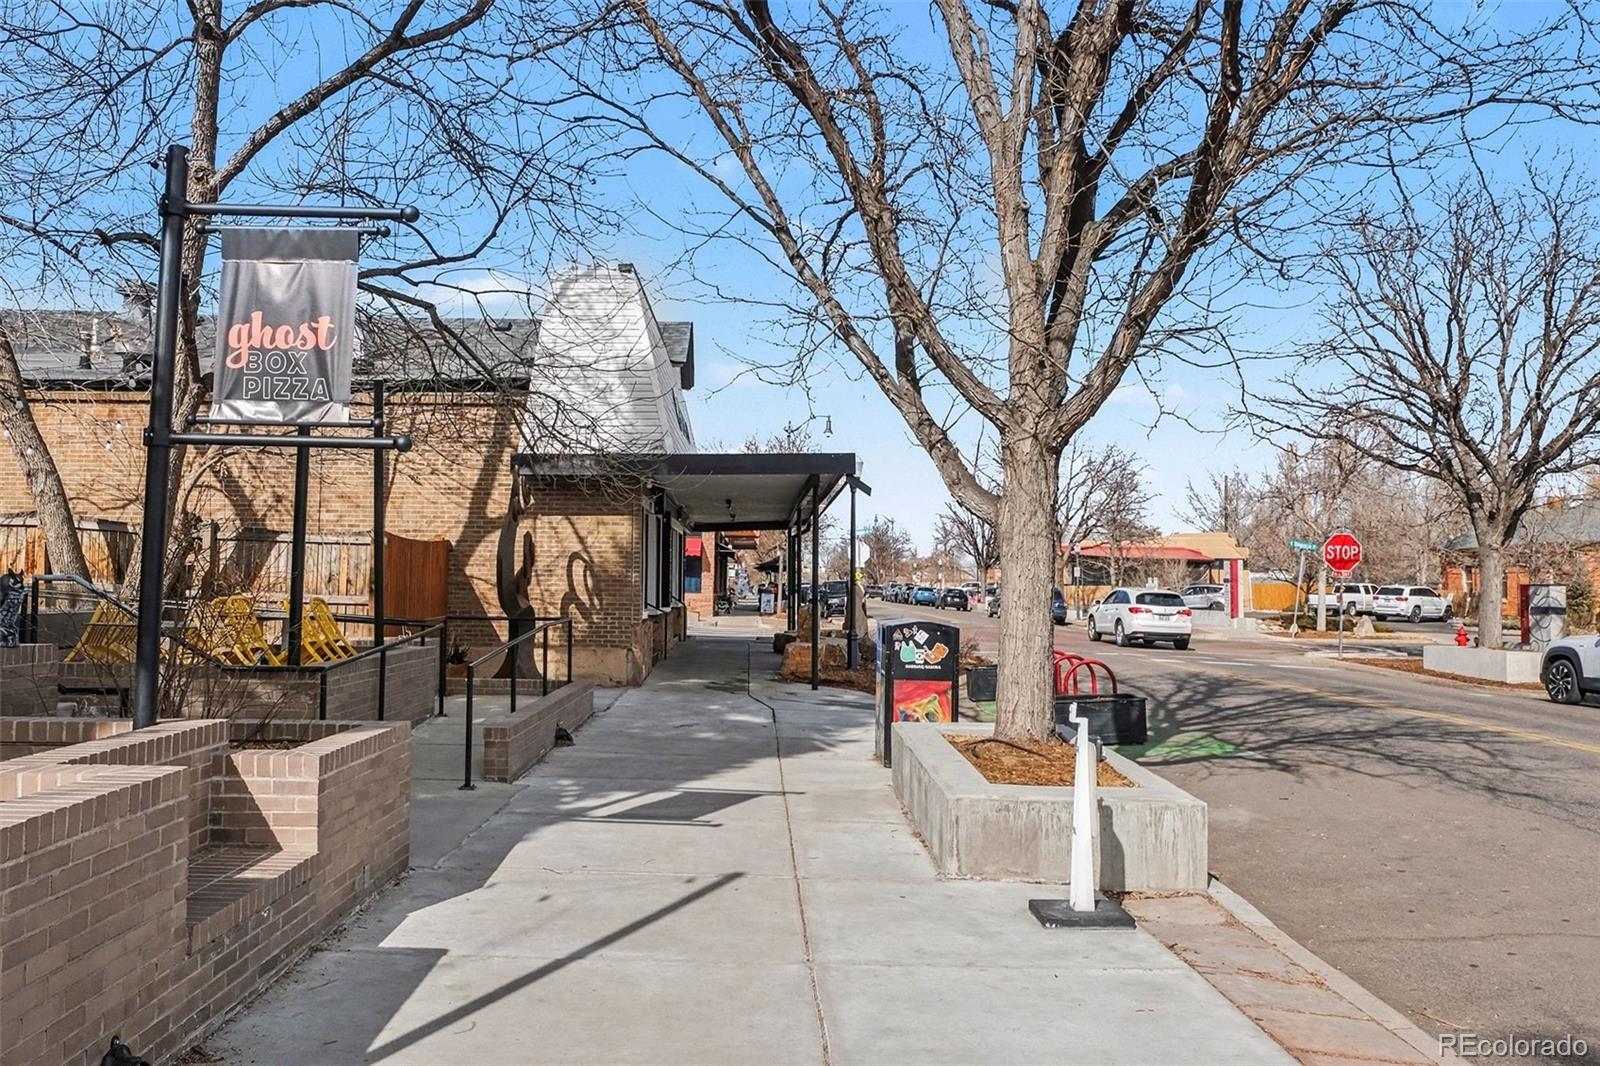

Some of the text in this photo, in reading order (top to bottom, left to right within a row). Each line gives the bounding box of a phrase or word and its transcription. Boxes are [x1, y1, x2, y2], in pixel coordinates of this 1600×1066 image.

[226, 311, 338, 369] ghost
[244, 351, 307, 374] BOX
[243, 376, 330, 400] PIZZA
[1326, 545, 1359, 560] STOP
